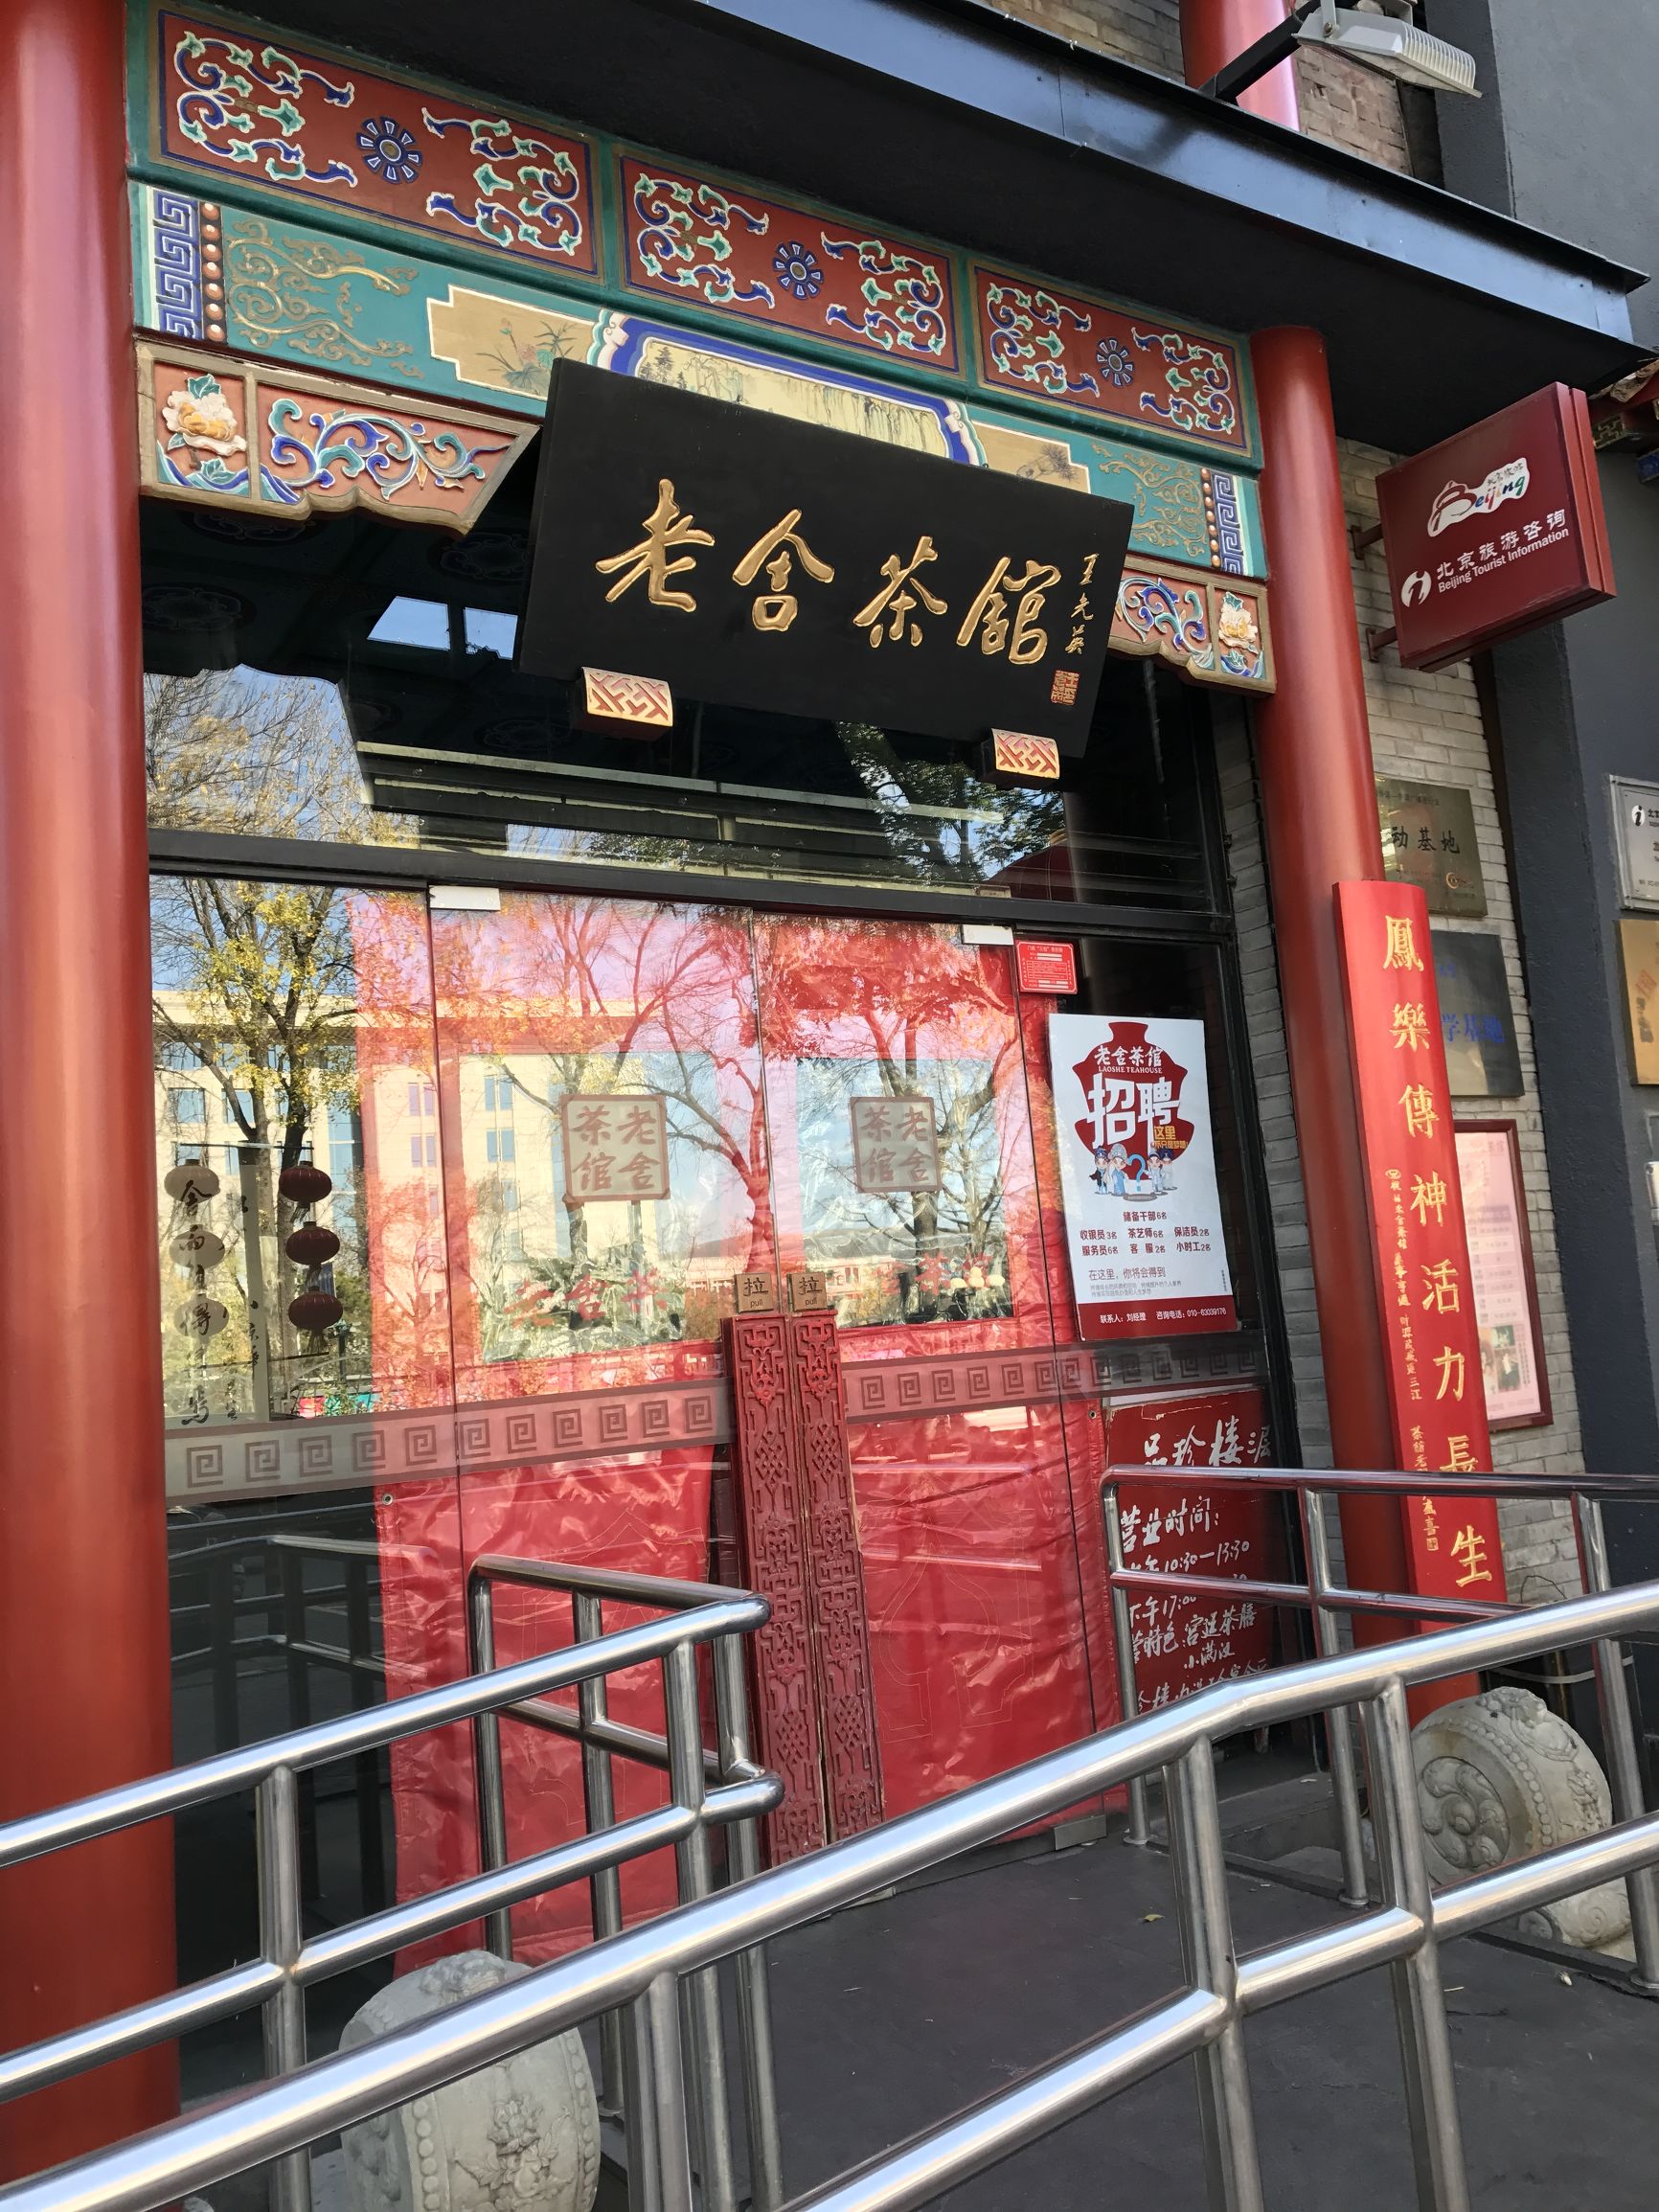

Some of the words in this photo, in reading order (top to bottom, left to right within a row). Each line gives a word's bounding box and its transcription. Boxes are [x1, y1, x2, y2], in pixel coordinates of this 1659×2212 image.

[1436, 509, 1566, 580] 北京旅游咨询
[1438, 571, 1472, 594] Beijing
[1472, 556, 1507, 578] Tourist
[1508, 528, 1570, 562] Information
[1392, 825, 1461, 855] 动基地
[1094, 1044, 1164, 1067] 老舍茶馆
[1086, 1072, 1180, 1155] 招聘
[1123, 1211, 1168, 1222] 储备干部6名
[1079, 1229, 1118, 1241] 收银员3名
[1127, 1227, 1164, 1239] 茶艺师6名
[1173, 1226, 1210, 1238] 保洁员2名
[1081, 1245, 1119, 1257] 服务员6名
[1176, 1242, 1212, 1253] 小时工2名
[742, 1276, 769, 1297] 拉
[798, 1276, 823, 1296] 拉
[750, 1299, 763, 1309] pull
[805, 1297, 818, 1306] pull
